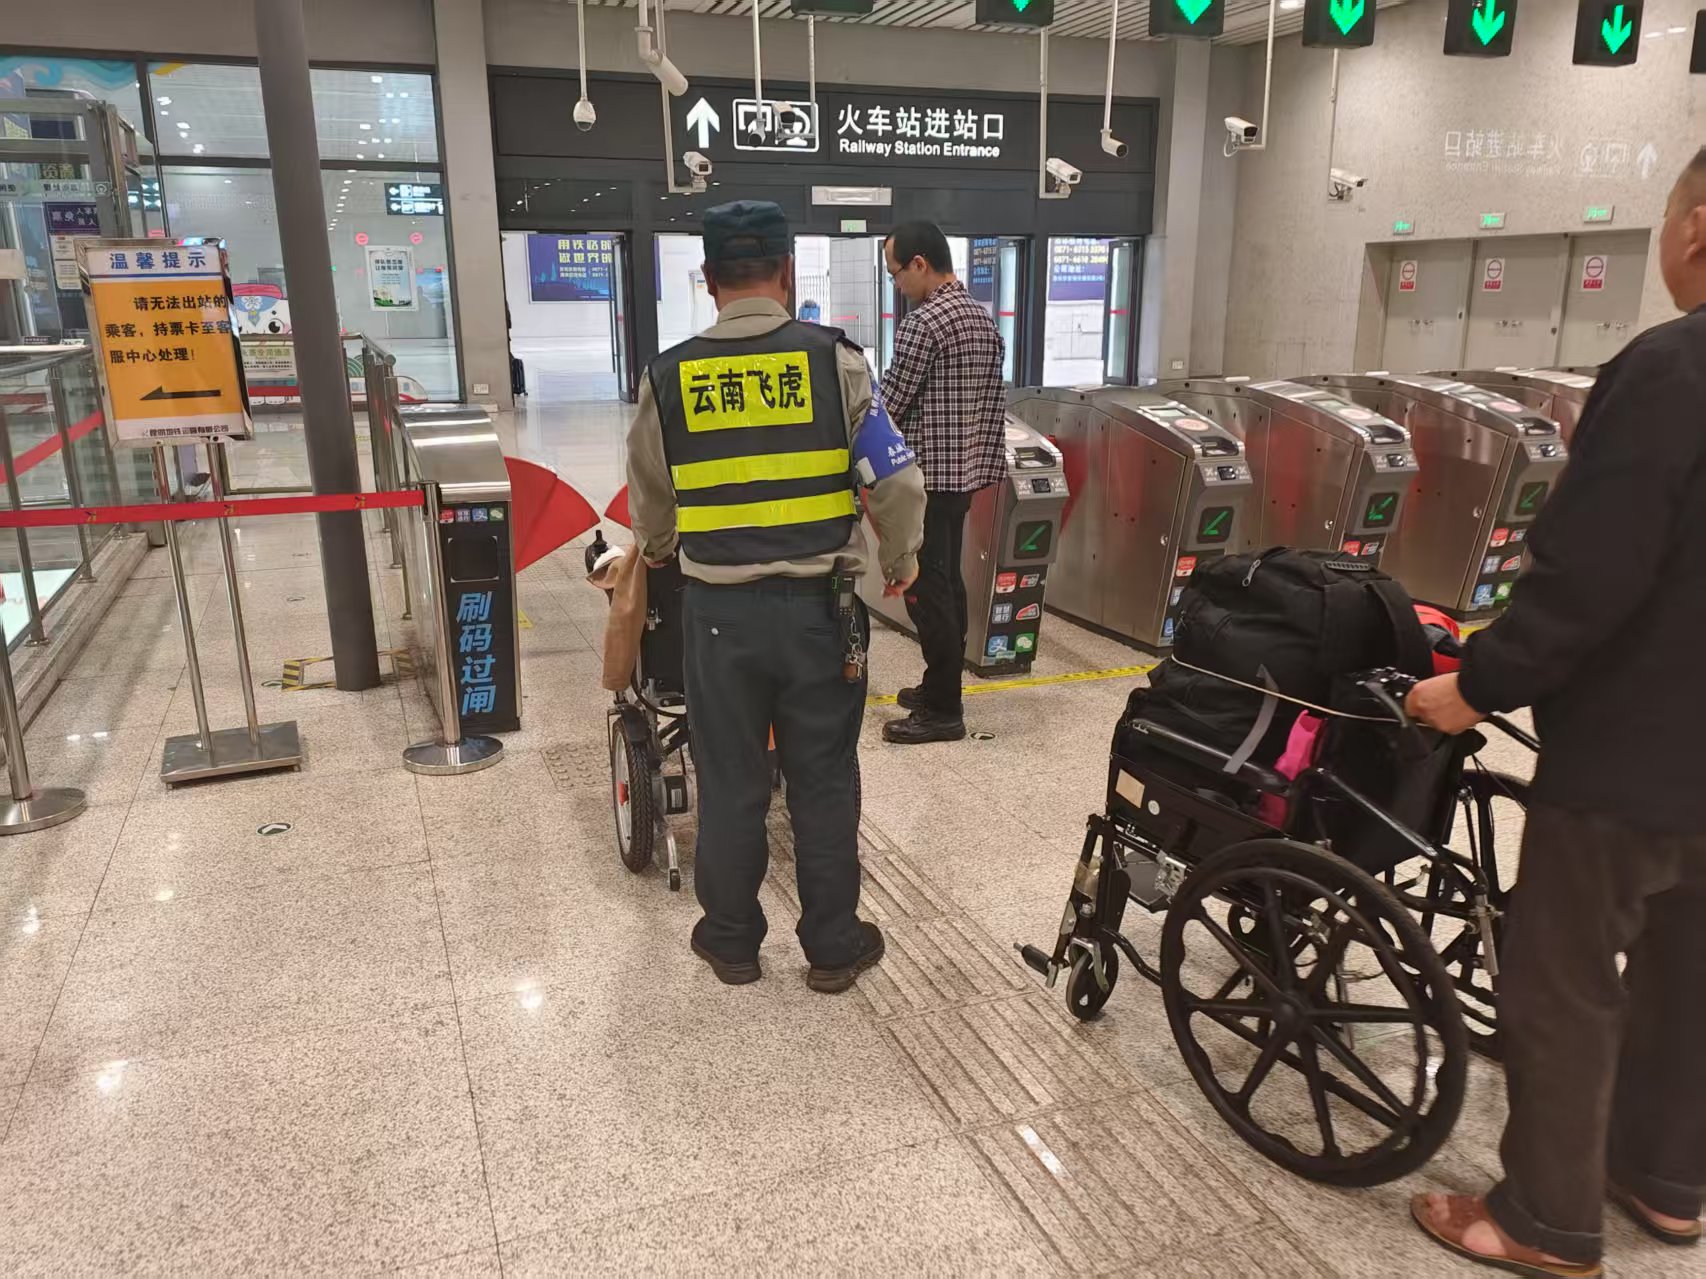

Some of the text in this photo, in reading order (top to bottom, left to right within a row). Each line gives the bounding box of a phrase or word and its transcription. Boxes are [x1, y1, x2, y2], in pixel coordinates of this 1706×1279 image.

[837, 104, 1004, 140] 火车站进站口
[839, 138, 1001, 158] Railway Station Entrance
[110, 251, 207, 270] 温馨提示
[134, 294, 227, 311] 请无法出站的
[105, 320, 232, 338] 乘客，持票卡至客
[110, 347, 196, 364] 服中心处理！
[689, 364, 806, 416] 云南飞虎
[456, 591, 497, 716] 刷码过闸
